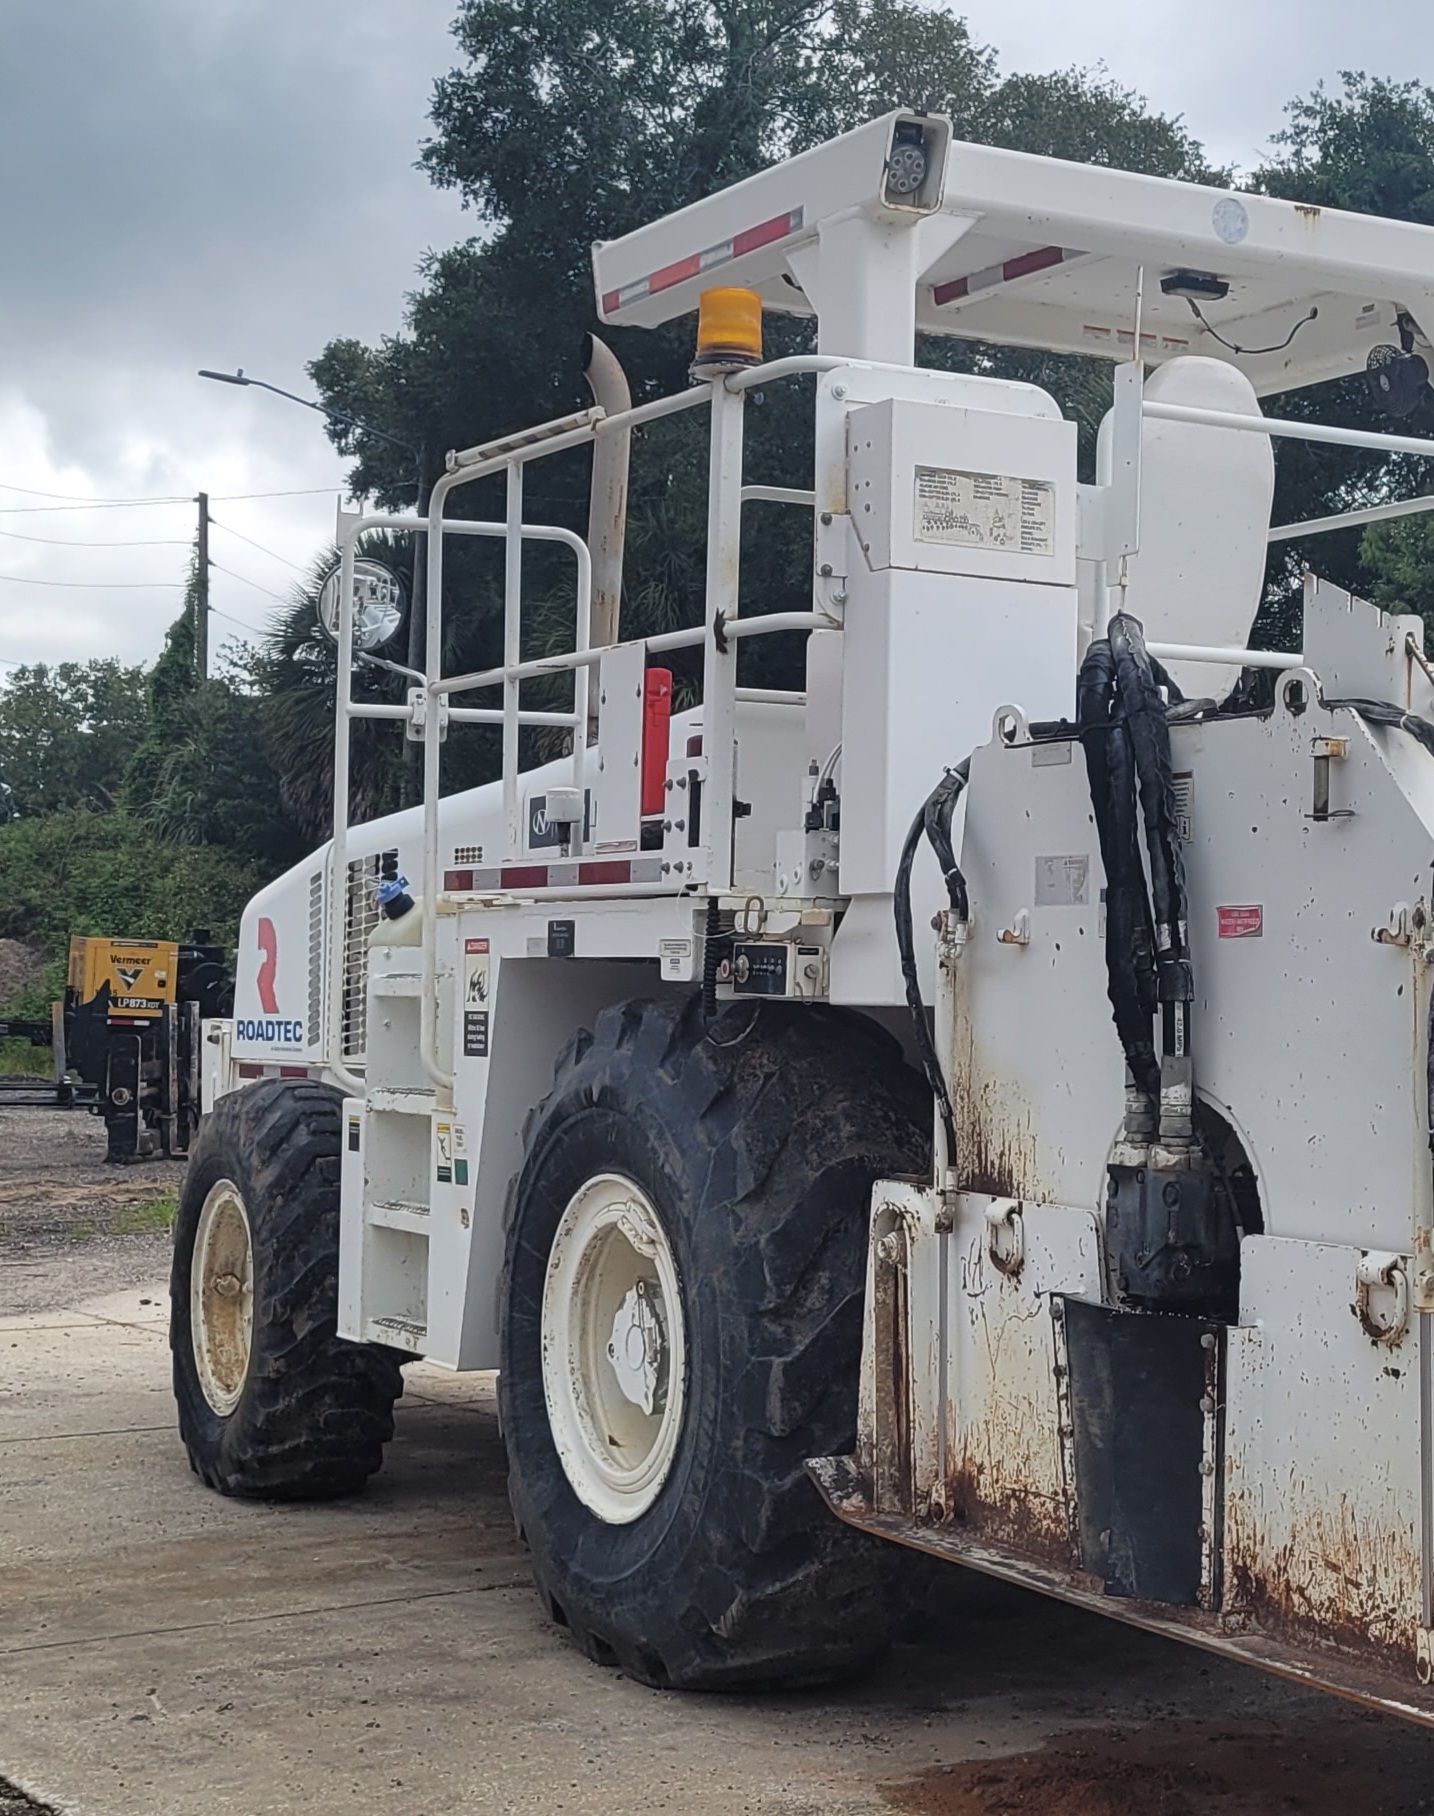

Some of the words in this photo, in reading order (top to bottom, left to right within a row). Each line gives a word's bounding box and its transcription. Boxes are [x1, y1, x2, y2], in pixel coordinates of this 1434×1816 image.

[110, 954, 152, 965] Vermeer
[117, 998, 147, 1009] LP873
[236, 1019, 303, 1042] ROADTEC
